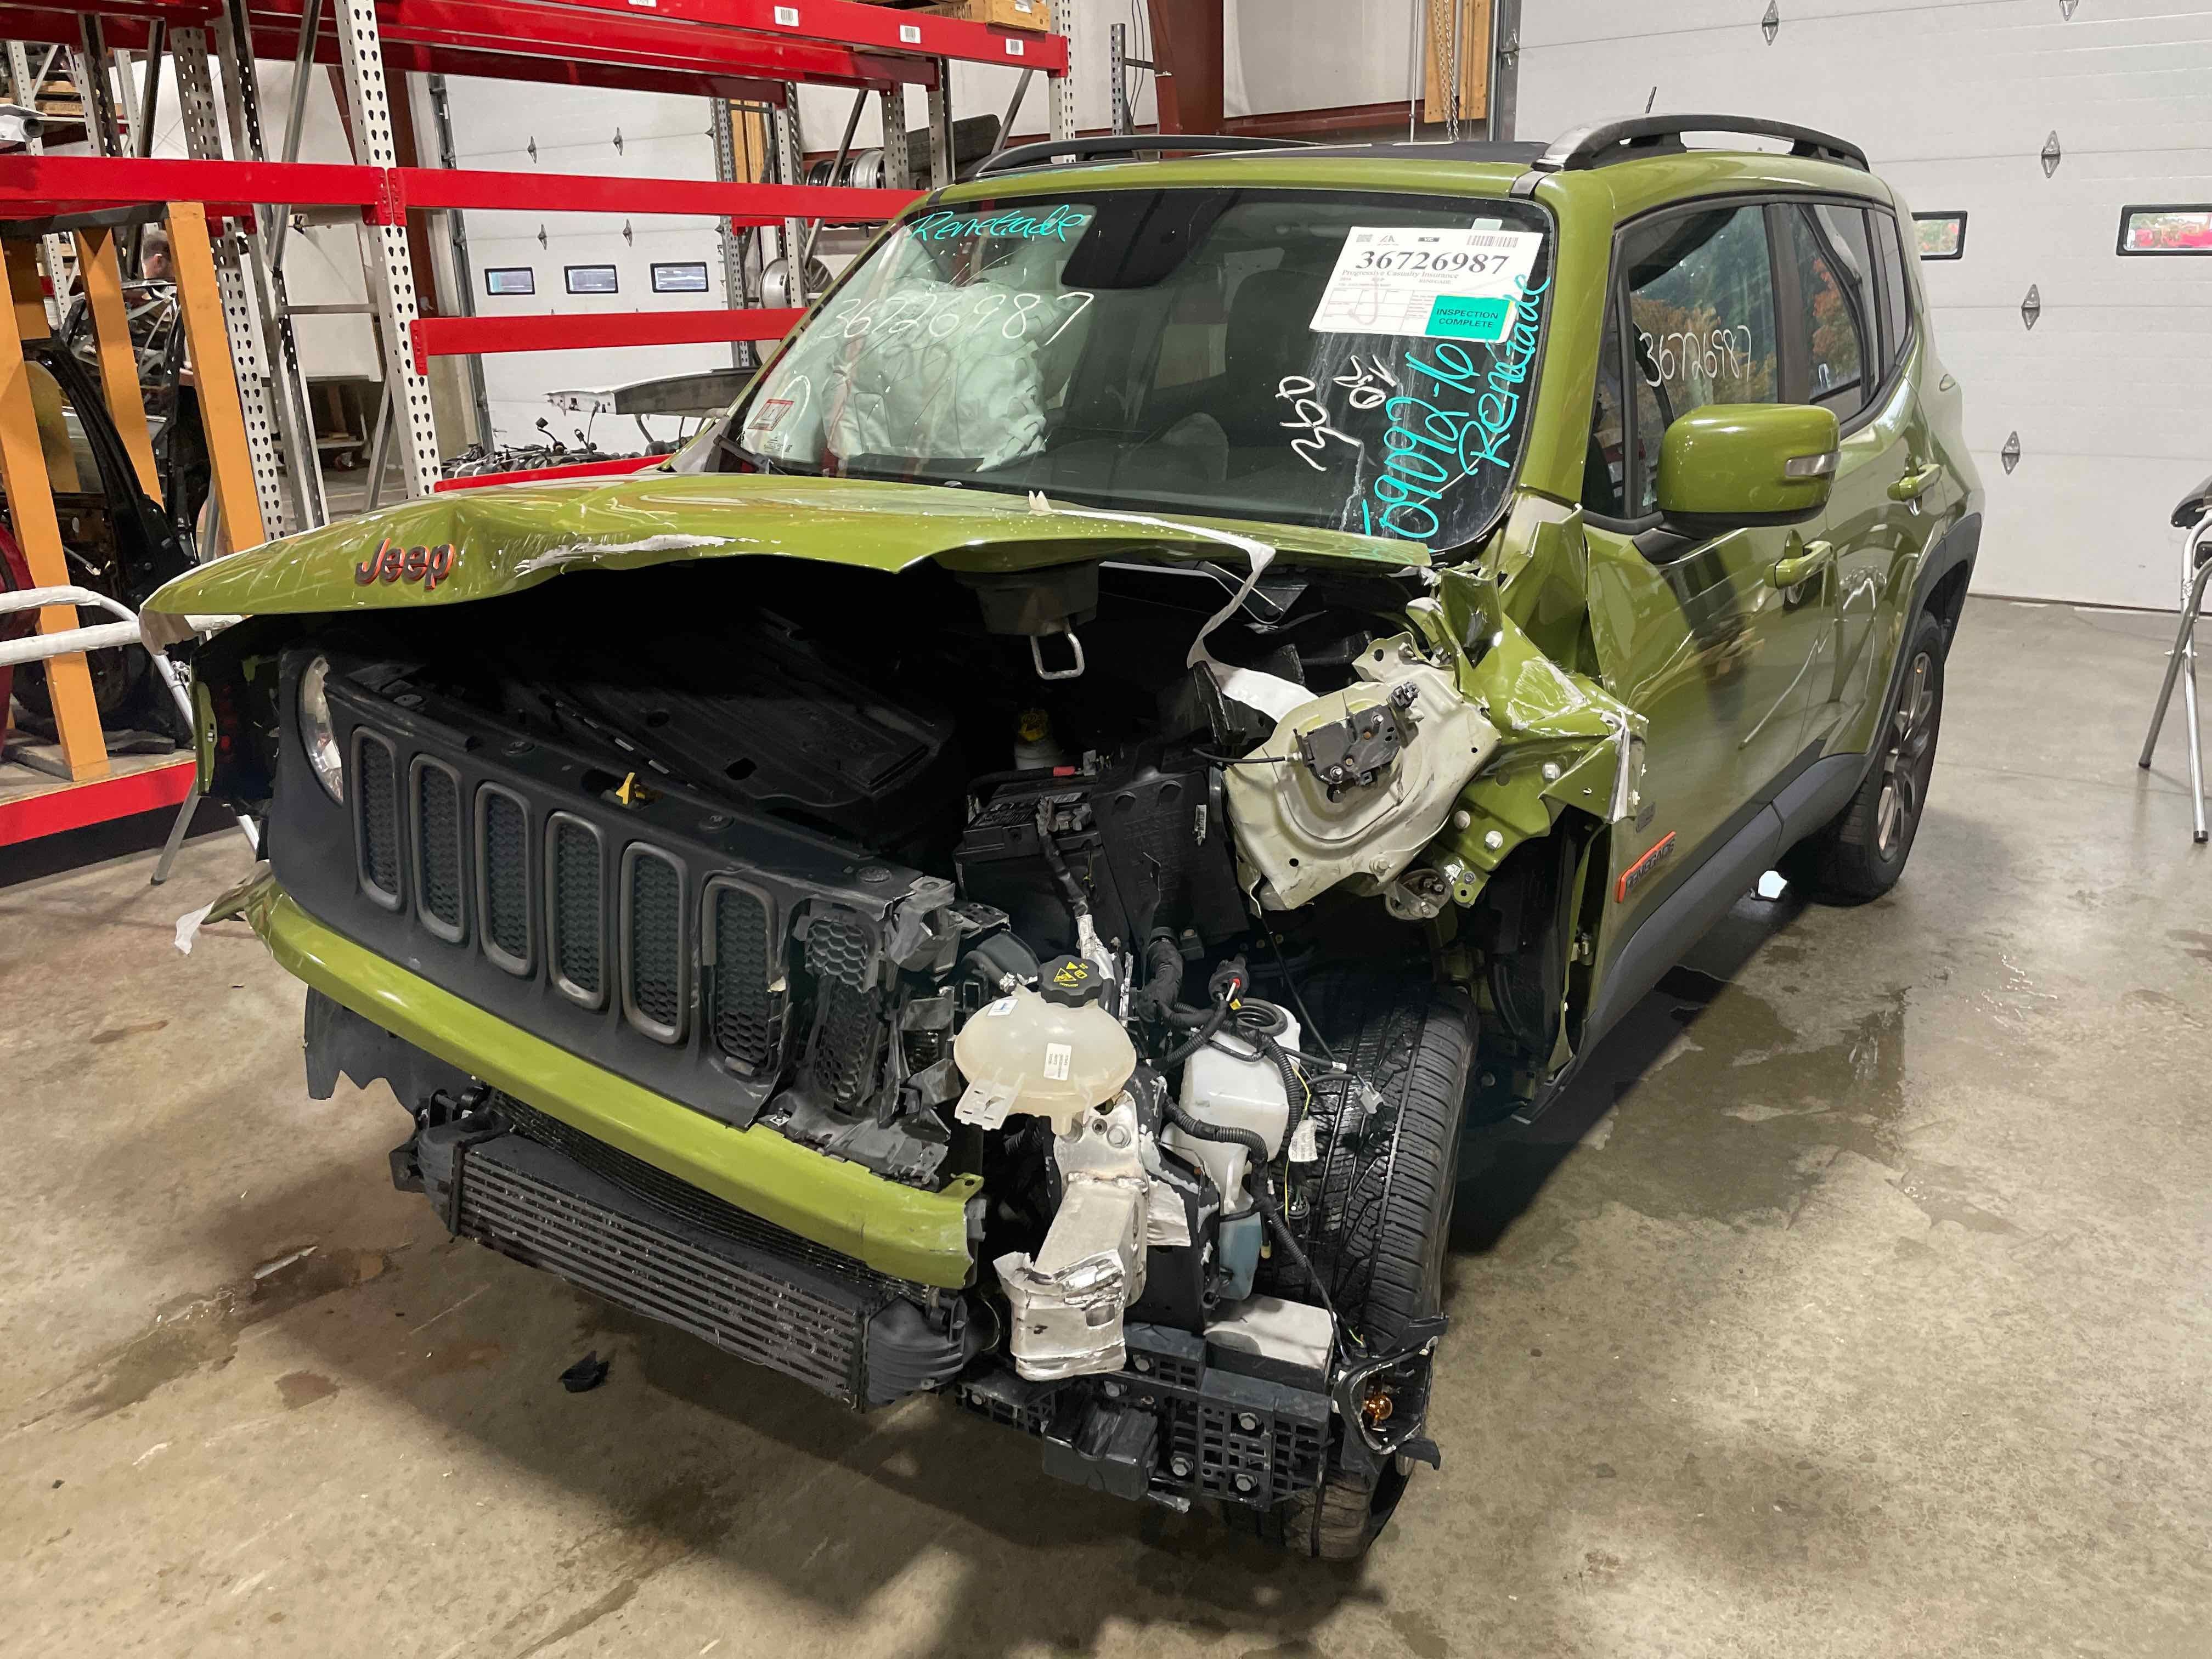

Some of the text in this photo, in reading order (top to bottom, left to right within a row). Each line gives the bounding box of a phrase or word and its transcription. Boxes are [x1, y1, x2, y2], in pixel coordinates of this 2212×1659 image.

[1356, 251, 1510, 274] 36726987
[820, 291, 1094, 346] 36726987
[1436, 308, 1499, 319] INSPECTION
[1438, 318, 1494, 328] COMPLETE
[1639, 325, 1752, 387] 36726987
[355, 538, 455, 591] Jeep
